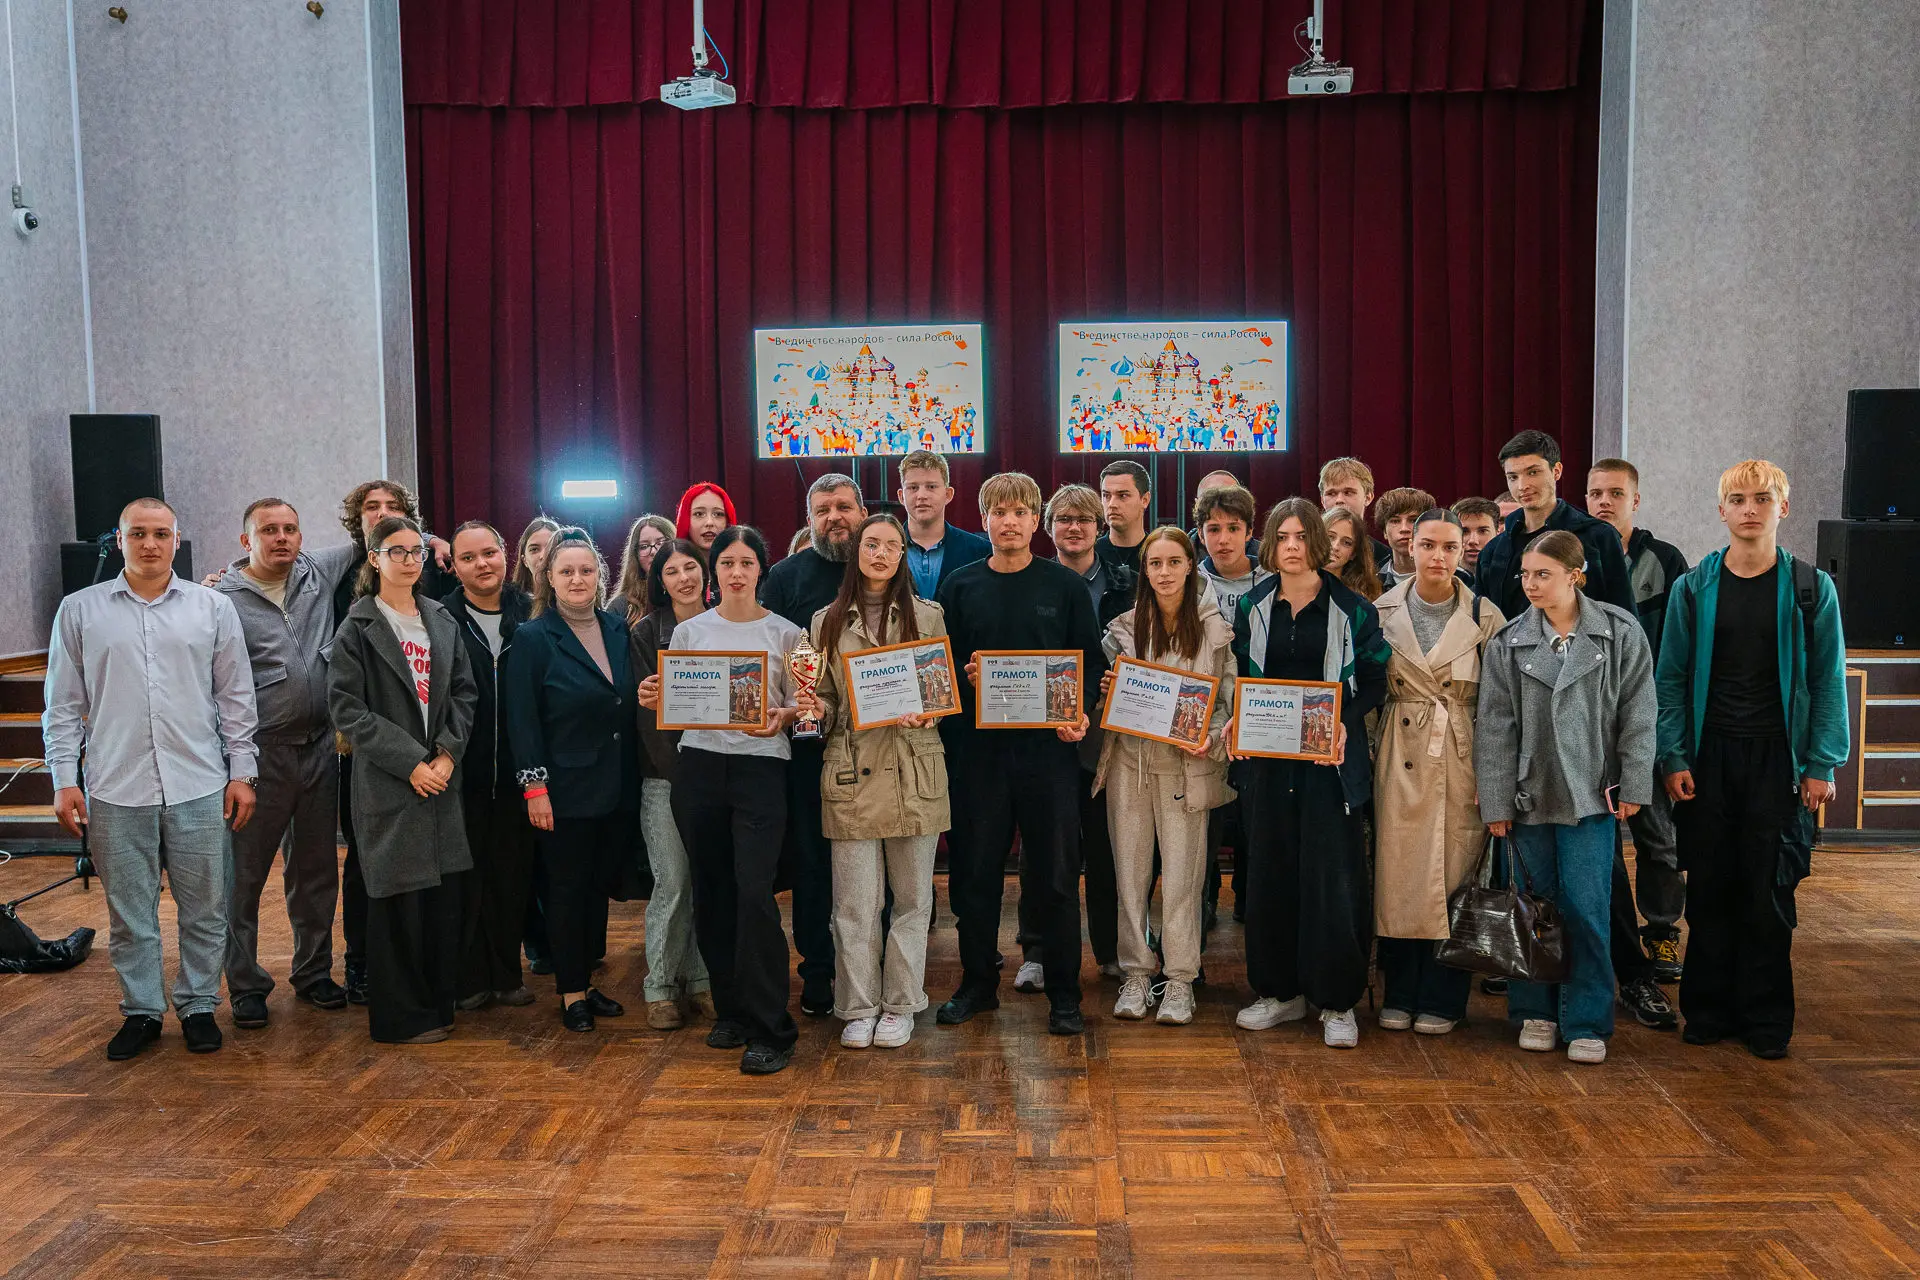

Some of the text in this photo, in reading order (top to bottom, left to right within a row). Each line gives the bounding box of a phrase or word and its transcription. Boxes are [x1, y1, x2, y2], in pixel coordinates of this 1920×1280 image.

[775, 336, 782, 345] В
[785, 337, 834, 347] единстве
[838, 336, 884, 346] народов
[896, 335, 921, 343] сила
[924, 333, 962, 343] России
[1079, 331, 1086, 340] В
[1089, 332, 1138, 341] единстве
[1143, 331, 1189, 341] народов
[1201, 331, 1227, 339] сила
[1230, 329, 1268, 339] России
[674, 671, 721, 680] ГРАМОТА
[861, 665, 908, 679] ГРАМОТА
[991, 671, 1038, 679] ГРАМОТА
[1126, 678, 1171, 695] ГРАМОТА
[1249, 699, 1294, 709] ГРАМОТА
